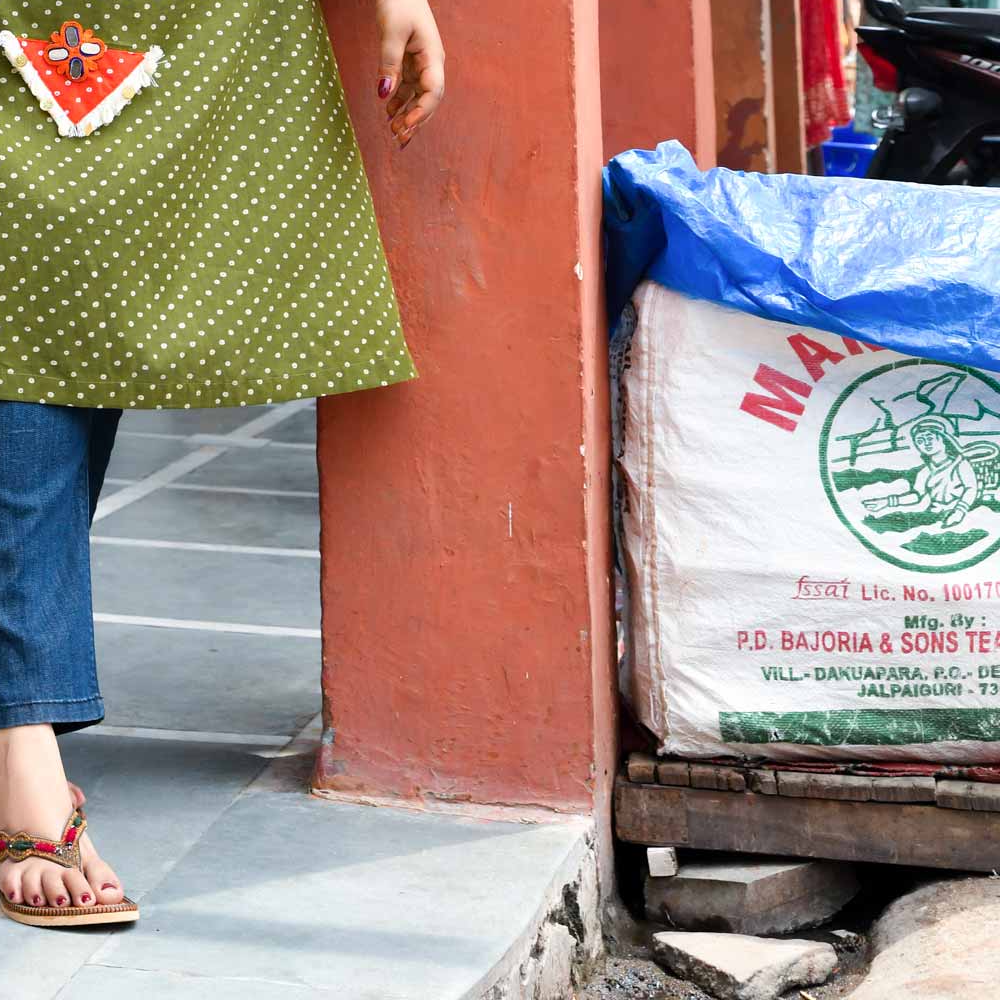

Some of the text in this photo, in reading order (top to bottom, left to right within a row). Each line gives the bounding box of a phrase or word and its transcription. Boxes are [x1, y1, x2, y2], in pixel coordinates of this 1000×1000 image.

[861, 584, 895, 601] Lic.
[903, 584, 935, 601] No.
[904, 615, 944, 631] Mfg.
[951, 613, 975, 630] By
[737, 630, 775, 651] P.D.
[781, 630, 873, 653] BAJORIA
[880, 632, 894, 654] &
[901, 631, 959, 654] SONS
[857, 683, 962, 698] JALPAIGURI
